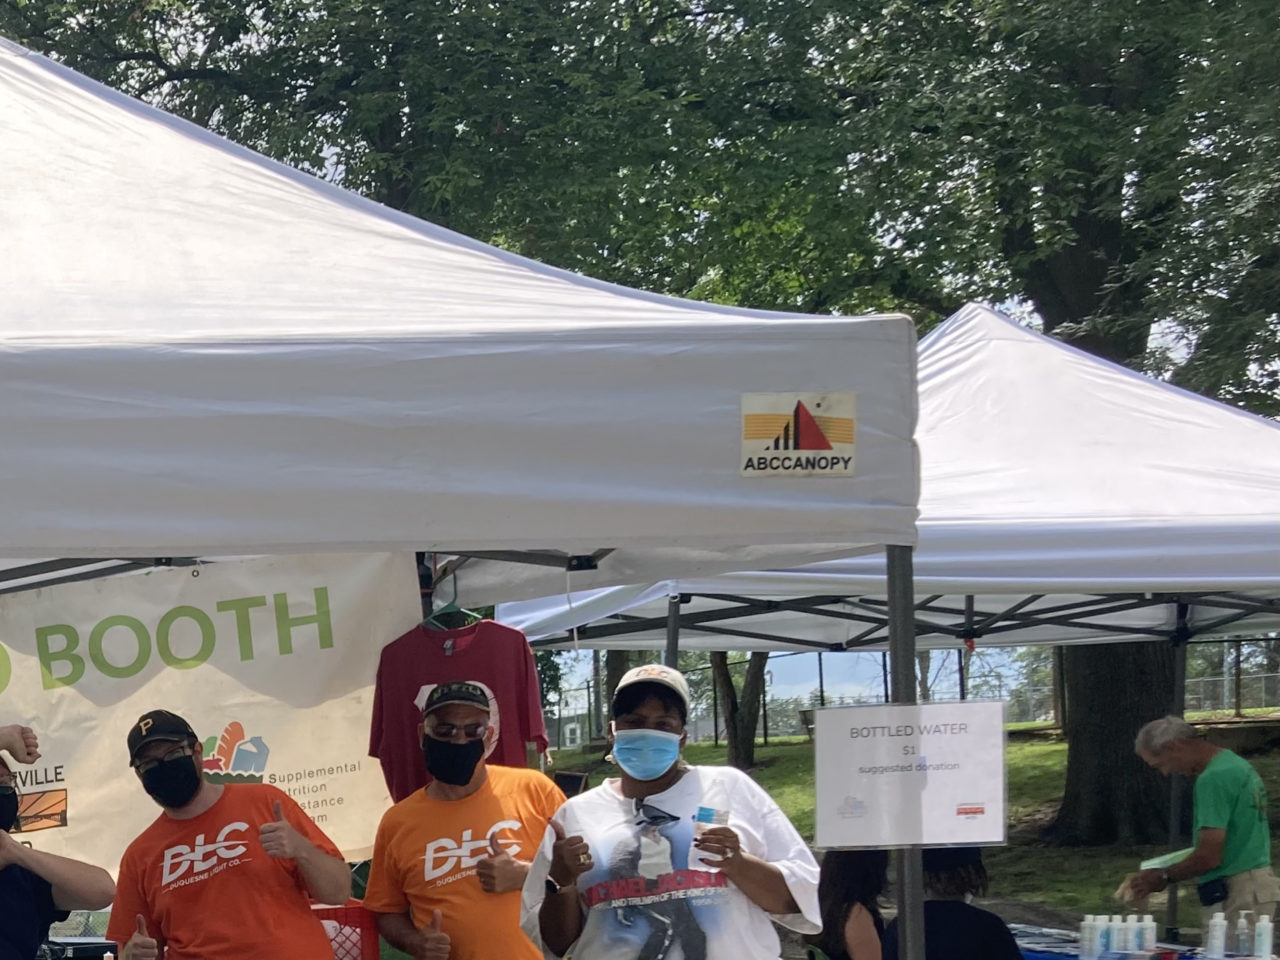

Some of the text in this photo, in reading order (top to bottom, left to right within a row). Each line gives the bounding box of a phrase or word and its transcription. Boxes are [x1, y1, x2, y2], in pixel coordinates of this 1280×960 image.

[743, 456, 852, 470] ABCCANOPY
[35, 586, 334, 691] BOOTH
[139, 718, 153, 735] P
[849, 723, 968, 738] BOTTLED WATER
[903, 745, 917, 755] $1
[269, 761, 361, 784] Supplemental
[858, 762, 960, 775] suggested donation
[170, 873, 209, 890] DUQUESNE
[611, 897, 628, 908] AND
[628, 893, 660, 906] TRIUMPH
[660, 892, 670, 902] OF
[671, 889, 687, 899] THE
